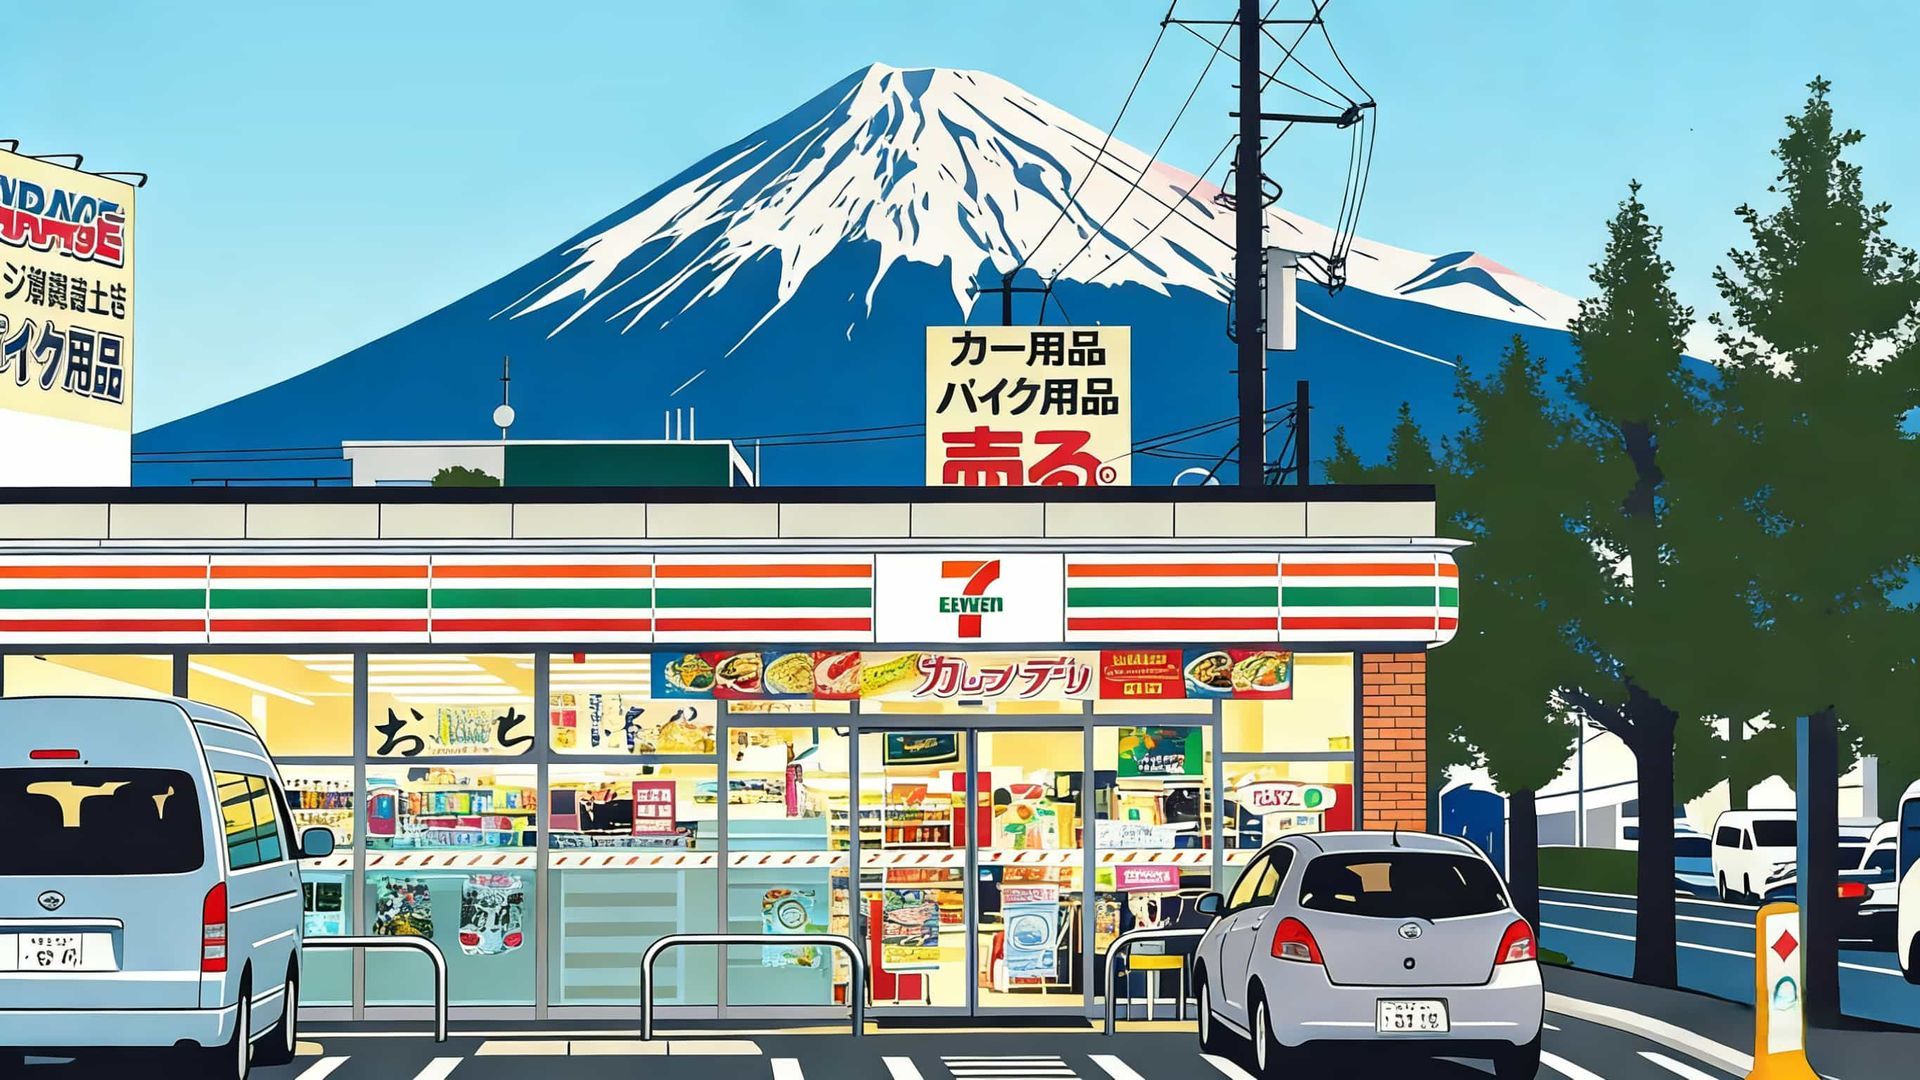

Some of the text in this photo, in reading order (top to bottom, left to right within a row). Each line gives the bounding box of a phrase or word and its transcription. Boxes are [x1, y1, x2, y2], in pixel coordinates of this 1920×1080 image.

[0, 318, 124, 402] イク用品
[950, 330, 1106, 367] カー用品
[936, 377, 1119, 416] バイク用品
